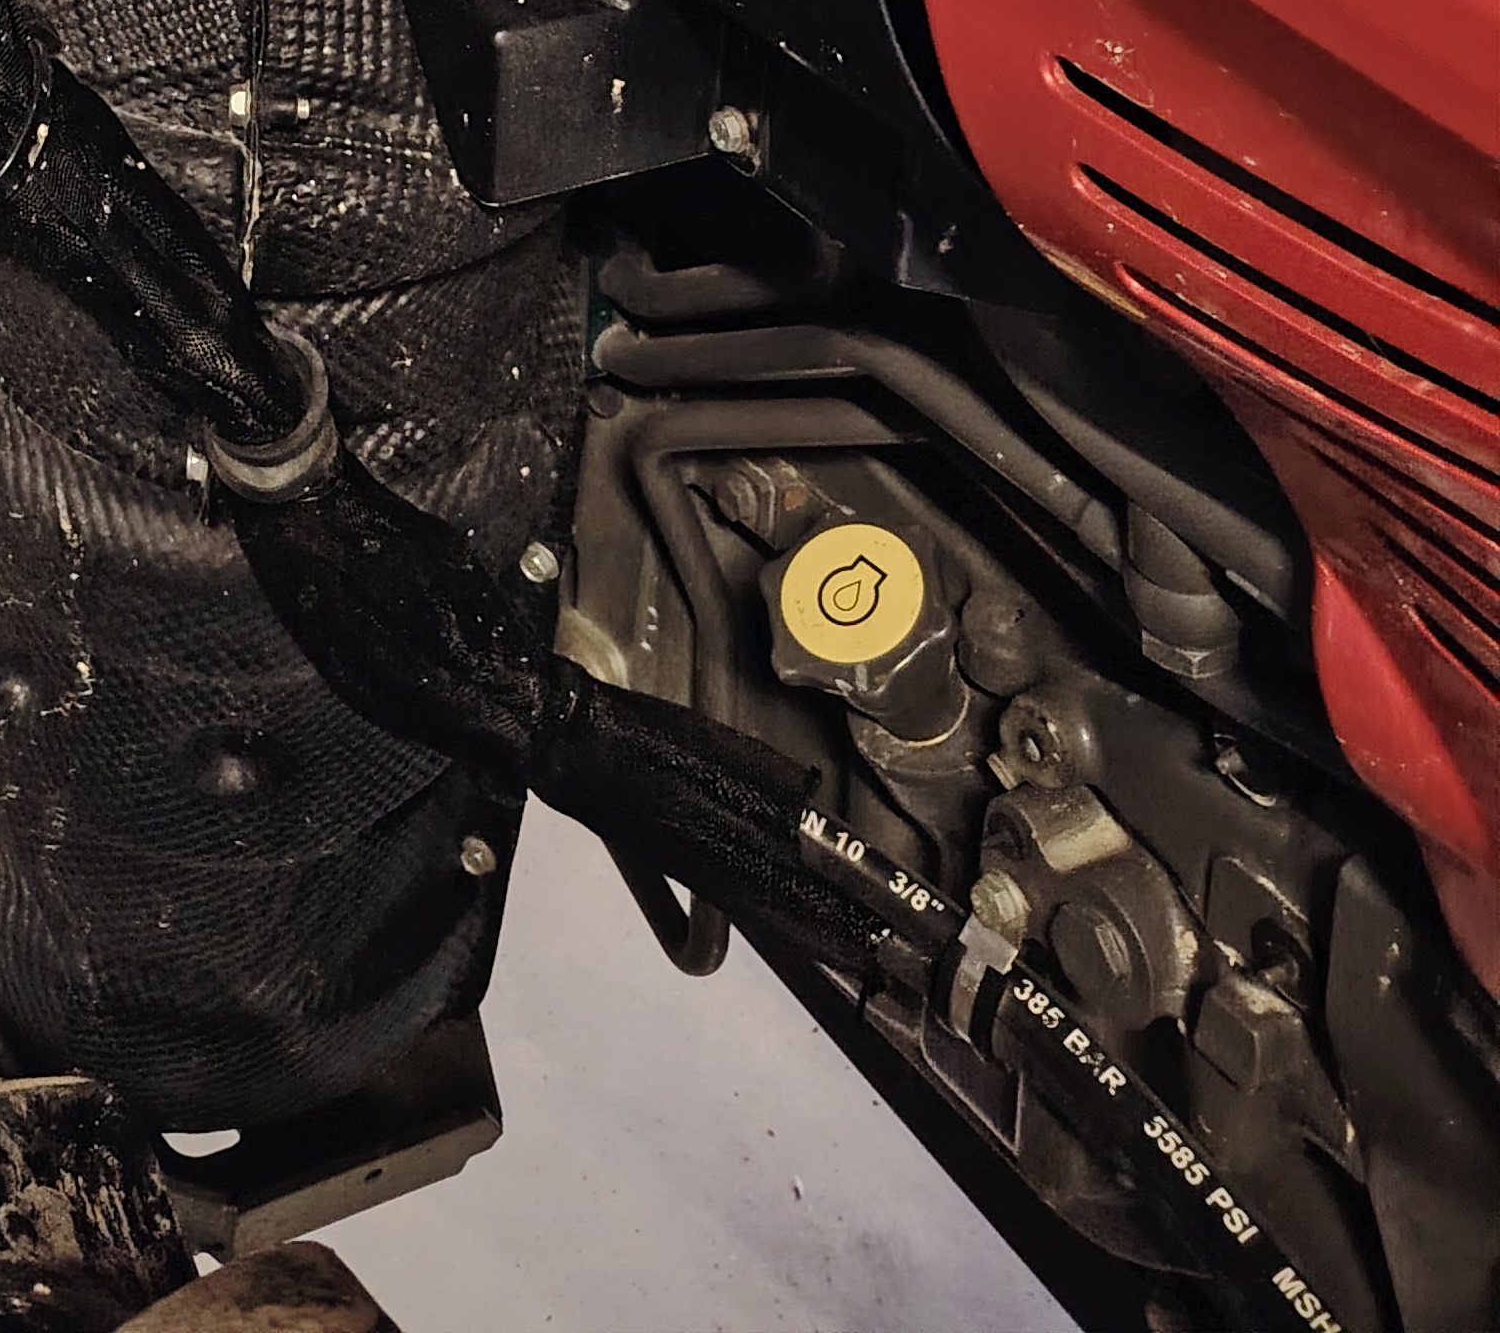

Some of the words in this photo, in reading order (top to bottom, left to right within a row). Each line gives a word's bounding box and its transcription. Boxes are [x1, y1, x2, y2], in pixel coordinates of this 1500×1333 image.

[835, 831, 865, 862] 10
[888, 871, 945, 912] 3/8"
[1013, 978, 1066, 1029] 385
[1143, 1115, 1211, 1186] 5585
[1205, 1186, 1260, 1244] PSI
